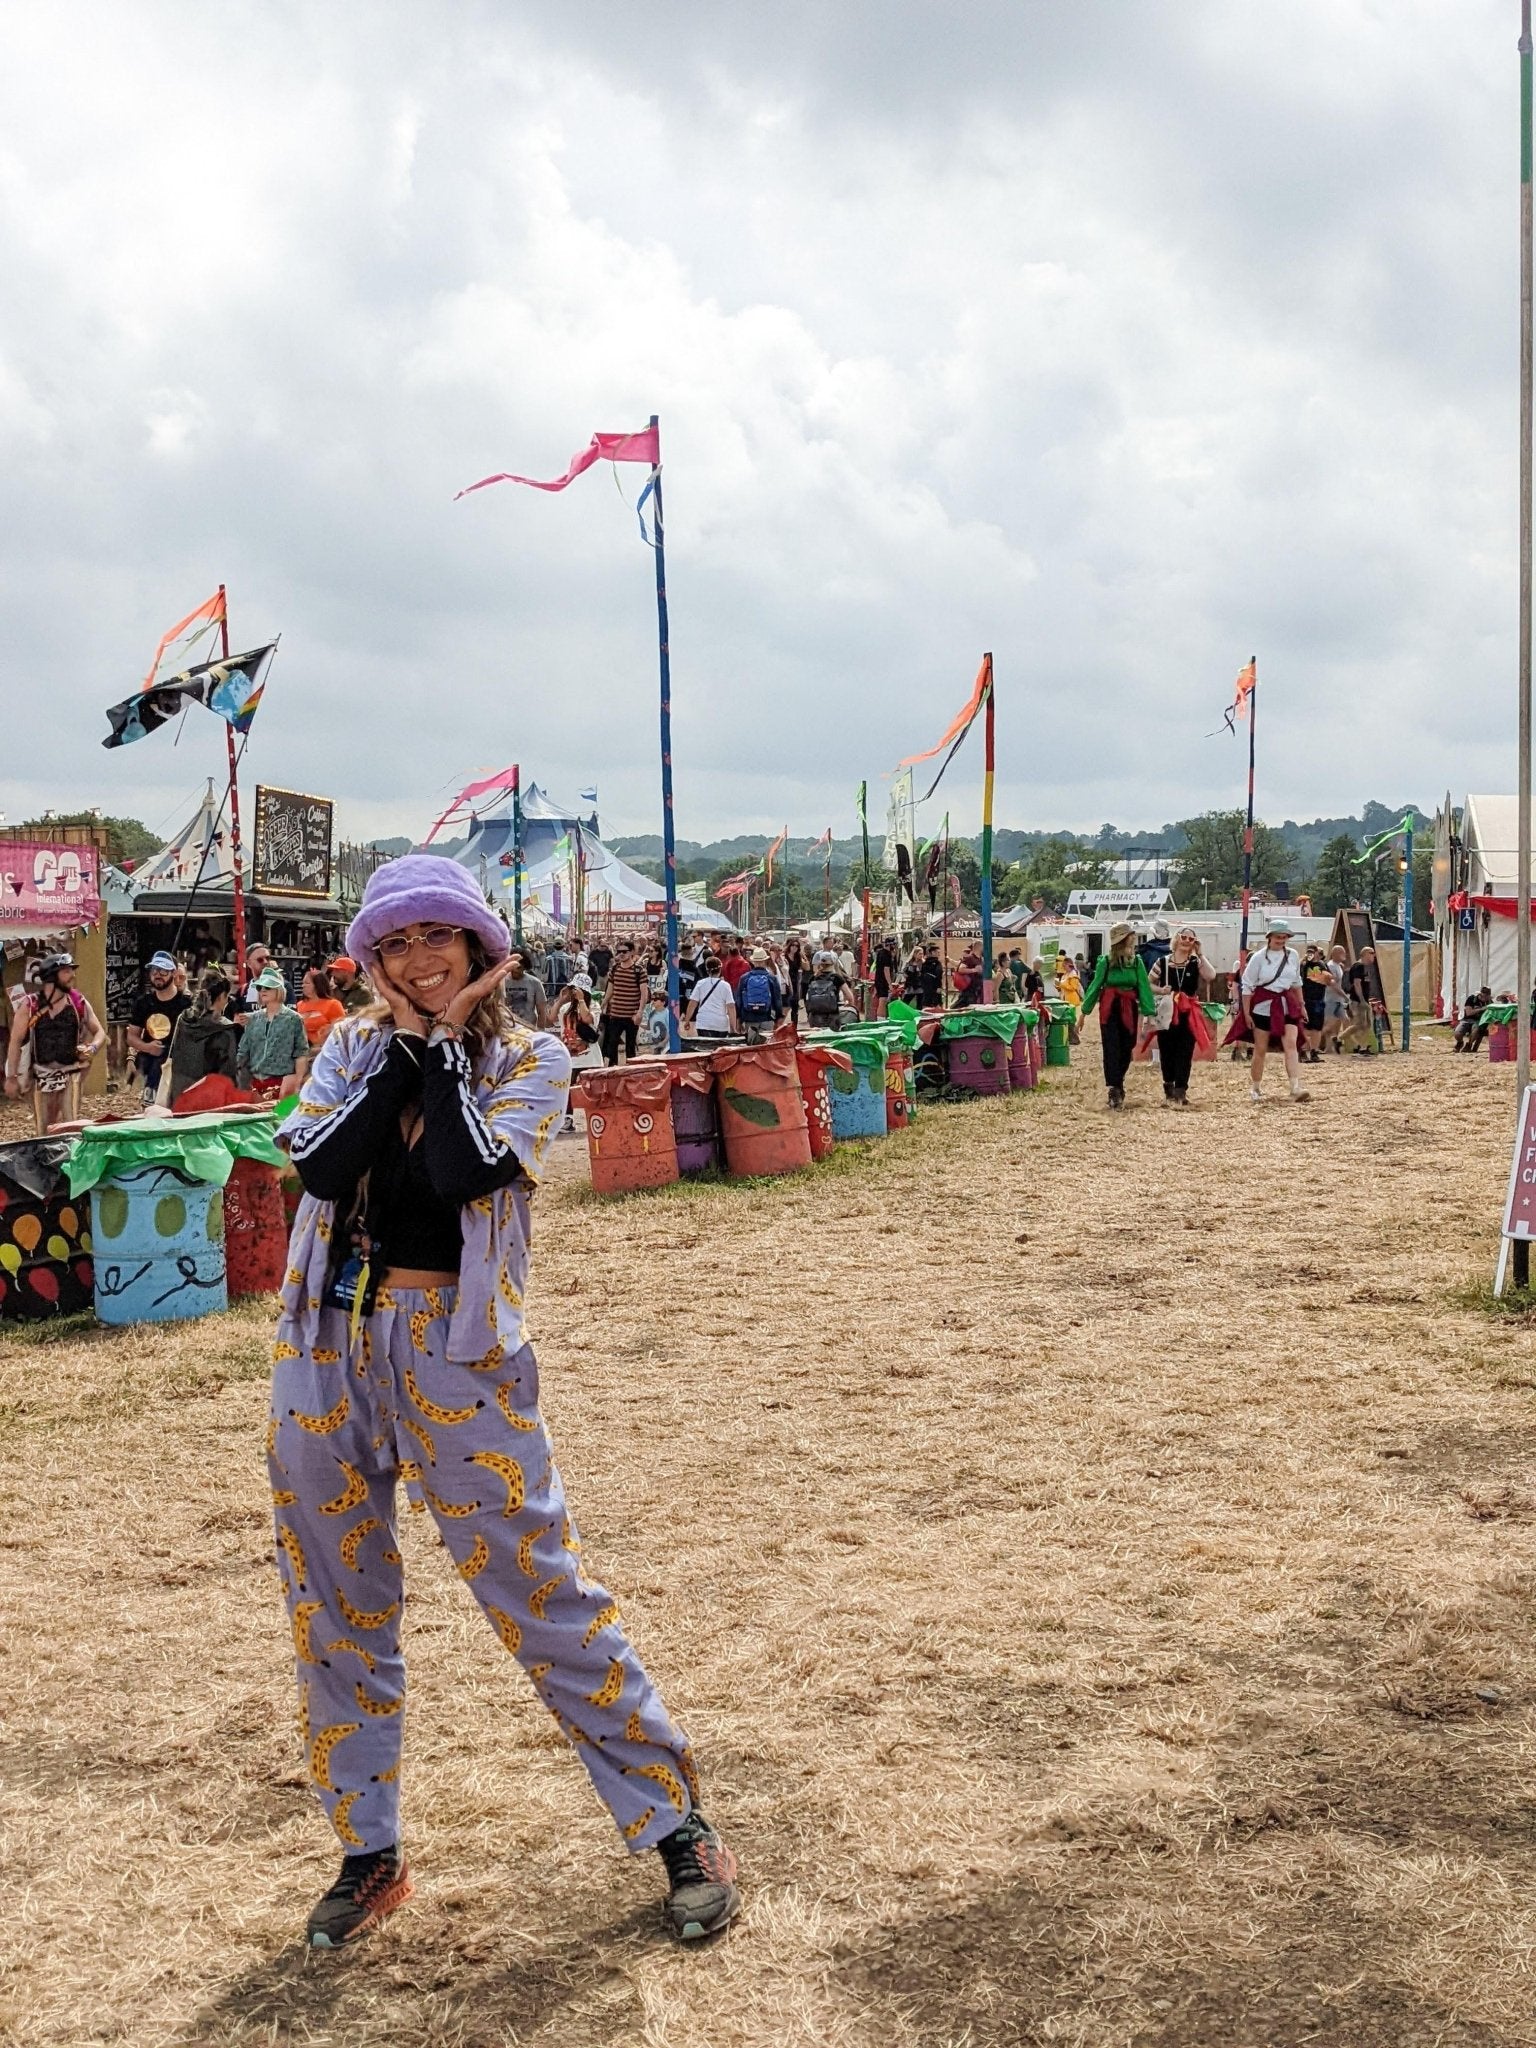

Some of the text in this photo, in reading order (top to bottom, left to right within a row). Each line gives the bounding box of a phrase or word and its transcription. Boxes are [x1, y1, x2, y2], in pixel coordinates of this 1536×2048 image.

[307, 804, 327, 823] Coffee
[36, 893, 84, 905] International
[1094, 893, 1141, 901] PHARMACY
[971, 930, 998, 938] TOT
